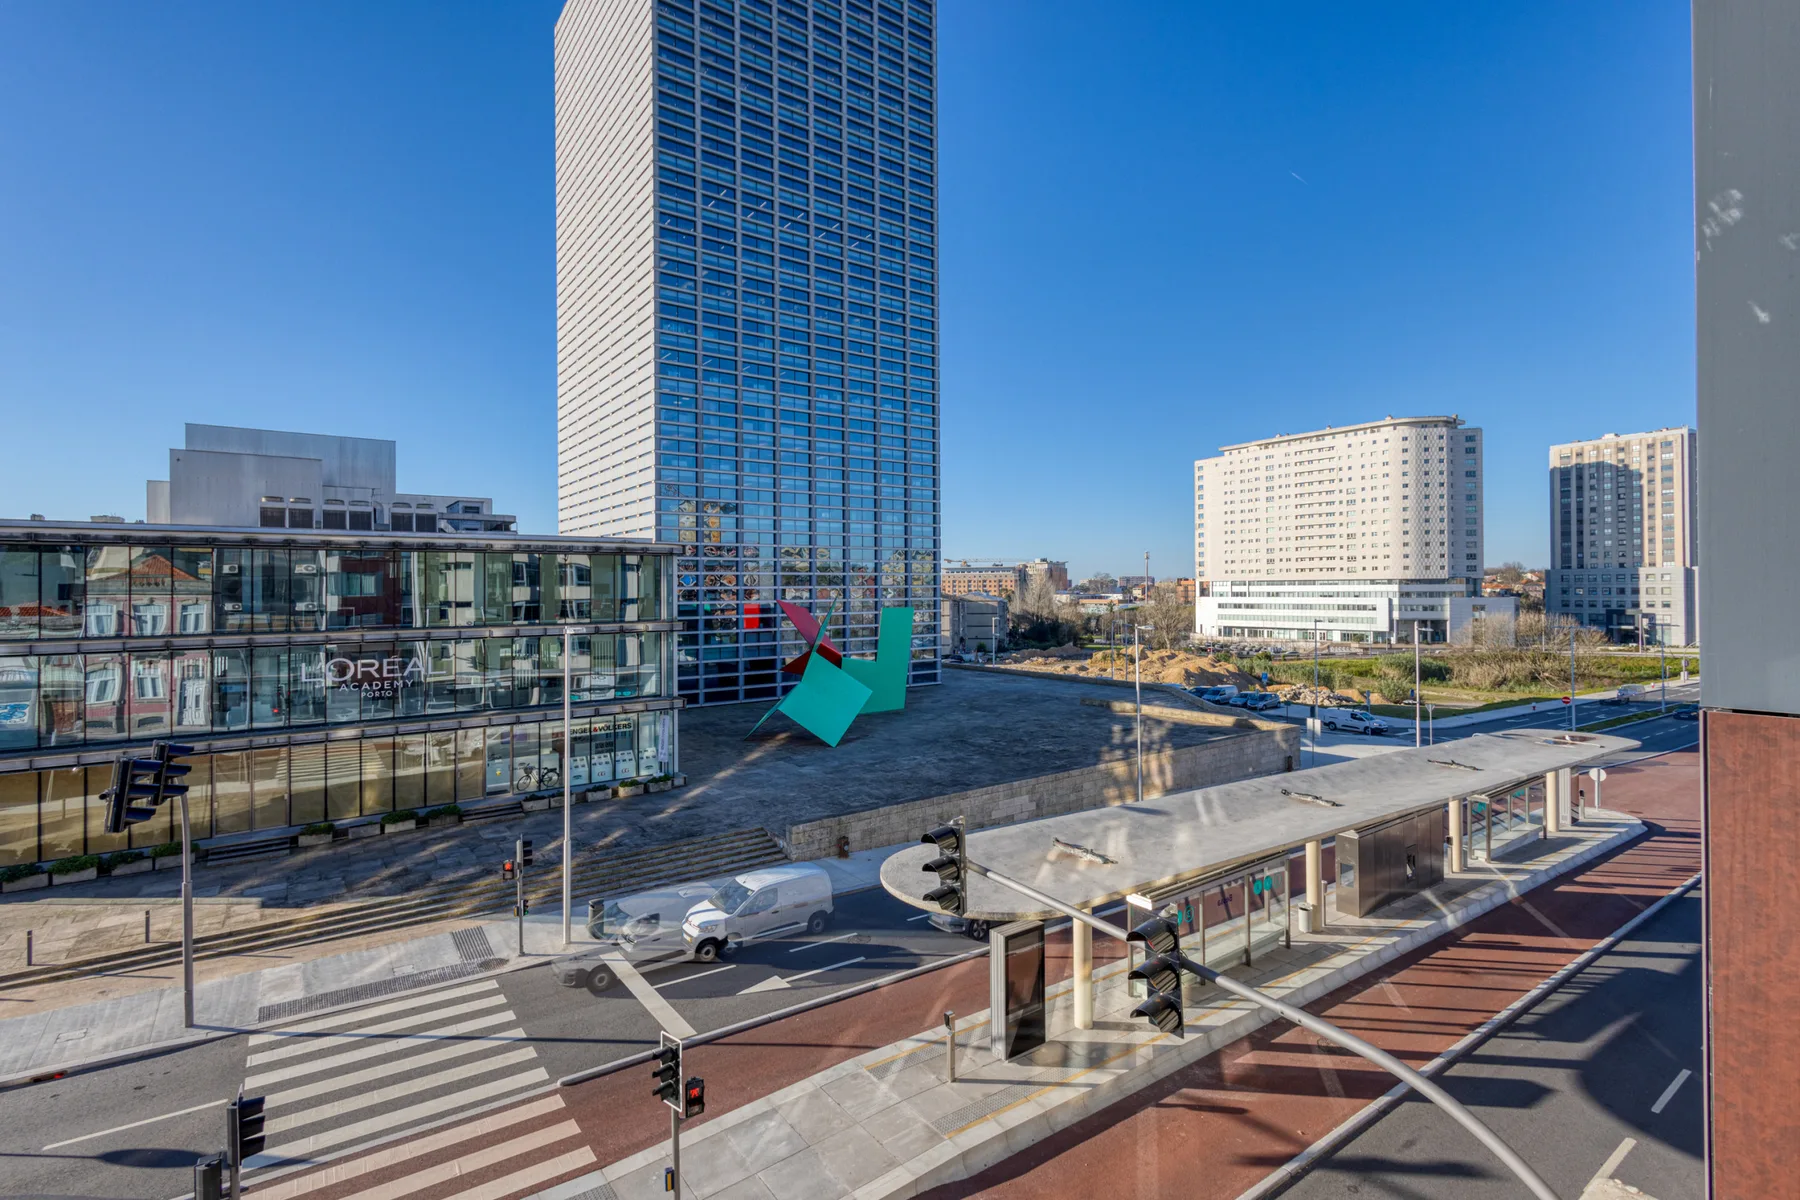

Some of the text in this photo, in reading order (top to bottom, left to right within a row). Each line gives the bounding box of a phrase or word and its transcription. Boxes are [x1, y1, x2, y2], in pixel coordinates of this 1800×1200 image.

[301, 656, 447, 682] L'ORÉAL
[339, 679, 414, 692] ACADEMY
[361, 690, 393, 698] PORTO
